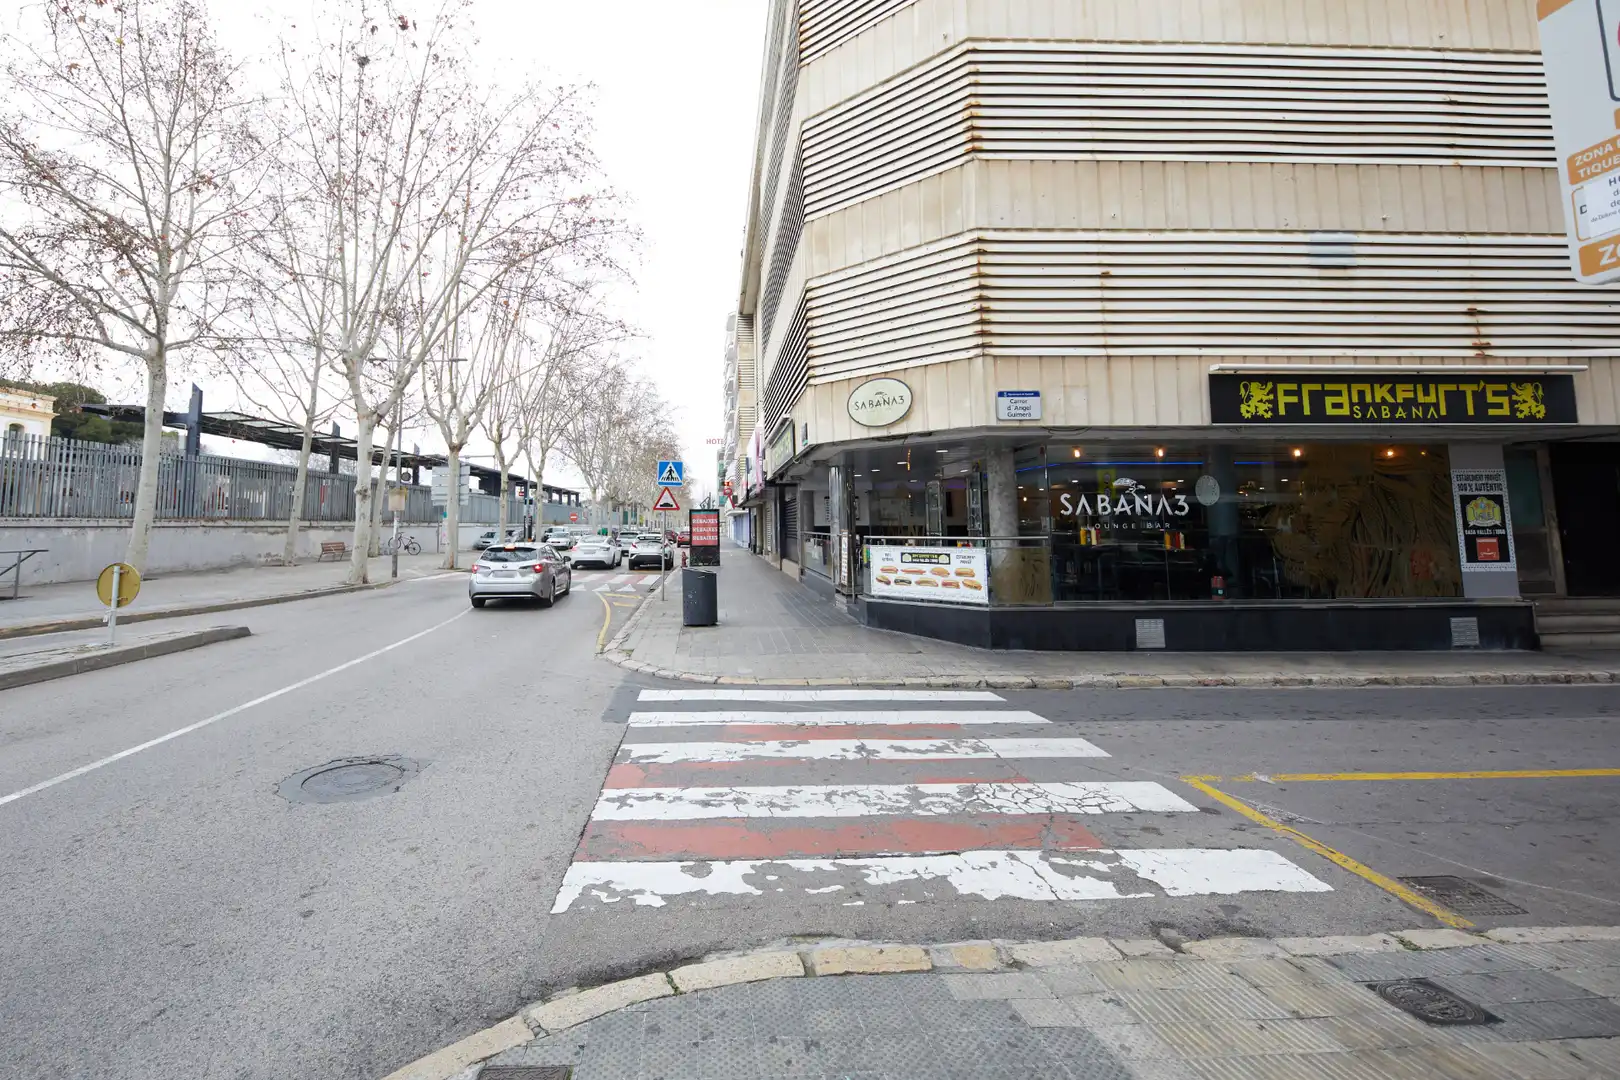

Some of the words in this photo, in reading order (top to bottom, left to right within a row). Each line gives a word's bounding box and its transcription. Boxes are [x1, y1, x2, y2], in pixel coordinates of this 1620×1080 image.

[1575, 144, 1613, 166] ZONA
[1609, 175, 1620, 186] H
[1353, 405, 1438, 418] SABANA
